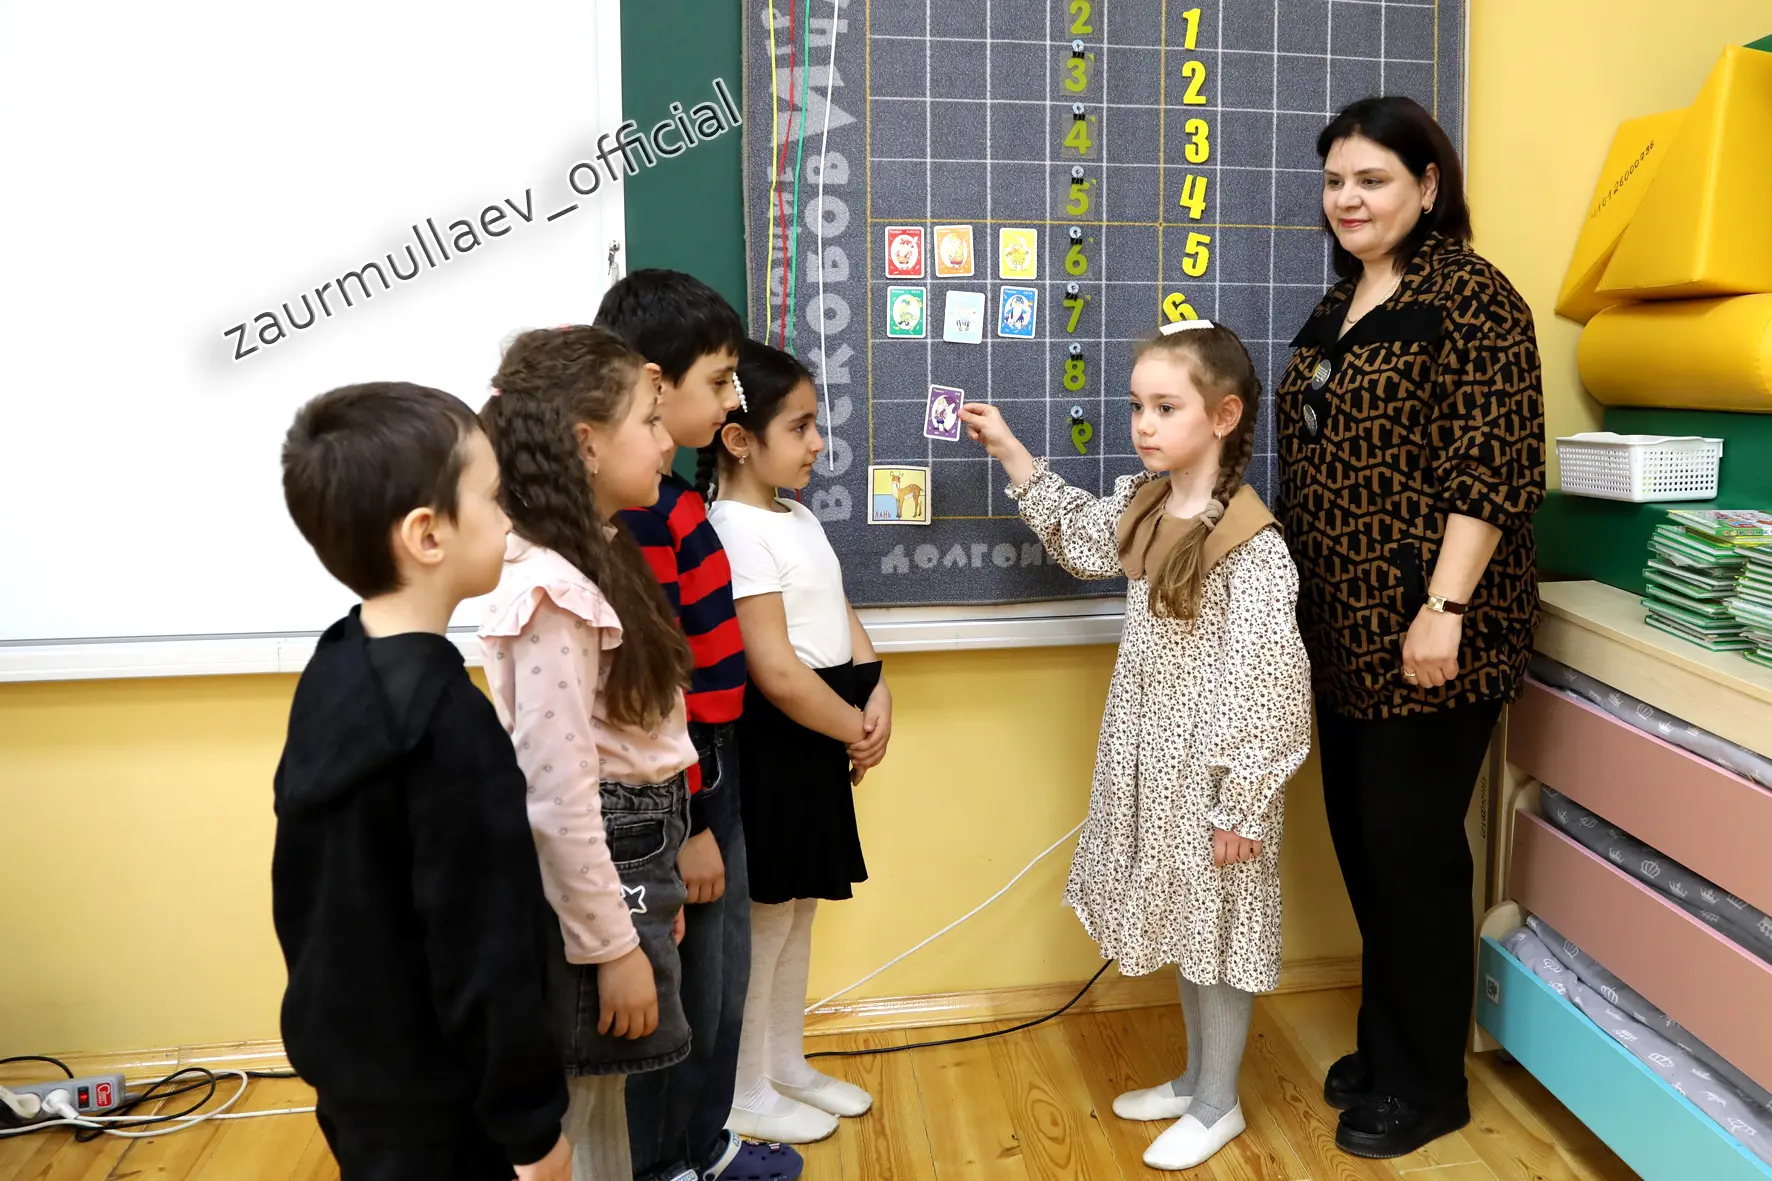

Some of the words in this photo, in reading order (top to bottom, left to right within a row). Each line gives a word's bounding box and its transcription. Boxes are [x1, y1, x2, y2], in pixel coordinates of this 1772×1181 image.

[1070, 0, 1092, 34] 2
[1182, 8, 1201, 50] 1
[1065, 57, 1087, 92] 3
[1182, 61, 1207, 105] 2
[1064, 119, 1091, 155] 4
[1185, 119, 1210, 164] 3
[1067, 182, 1089, 216] 5
[1180, 175, 1208, 220] 4
[788, 0, 857, 522] ВОСКОБОВИЧ
[1065, 244, 1088, 276] 6
[1182, 232, 1212, 277] 5
[1063, 298, 1085, 333] 7
[1163, 292, 1199, 323] 6
[1063, 358, 1086, 392] 8
[881, 543, 1056, 574] ДОЛГОИ
